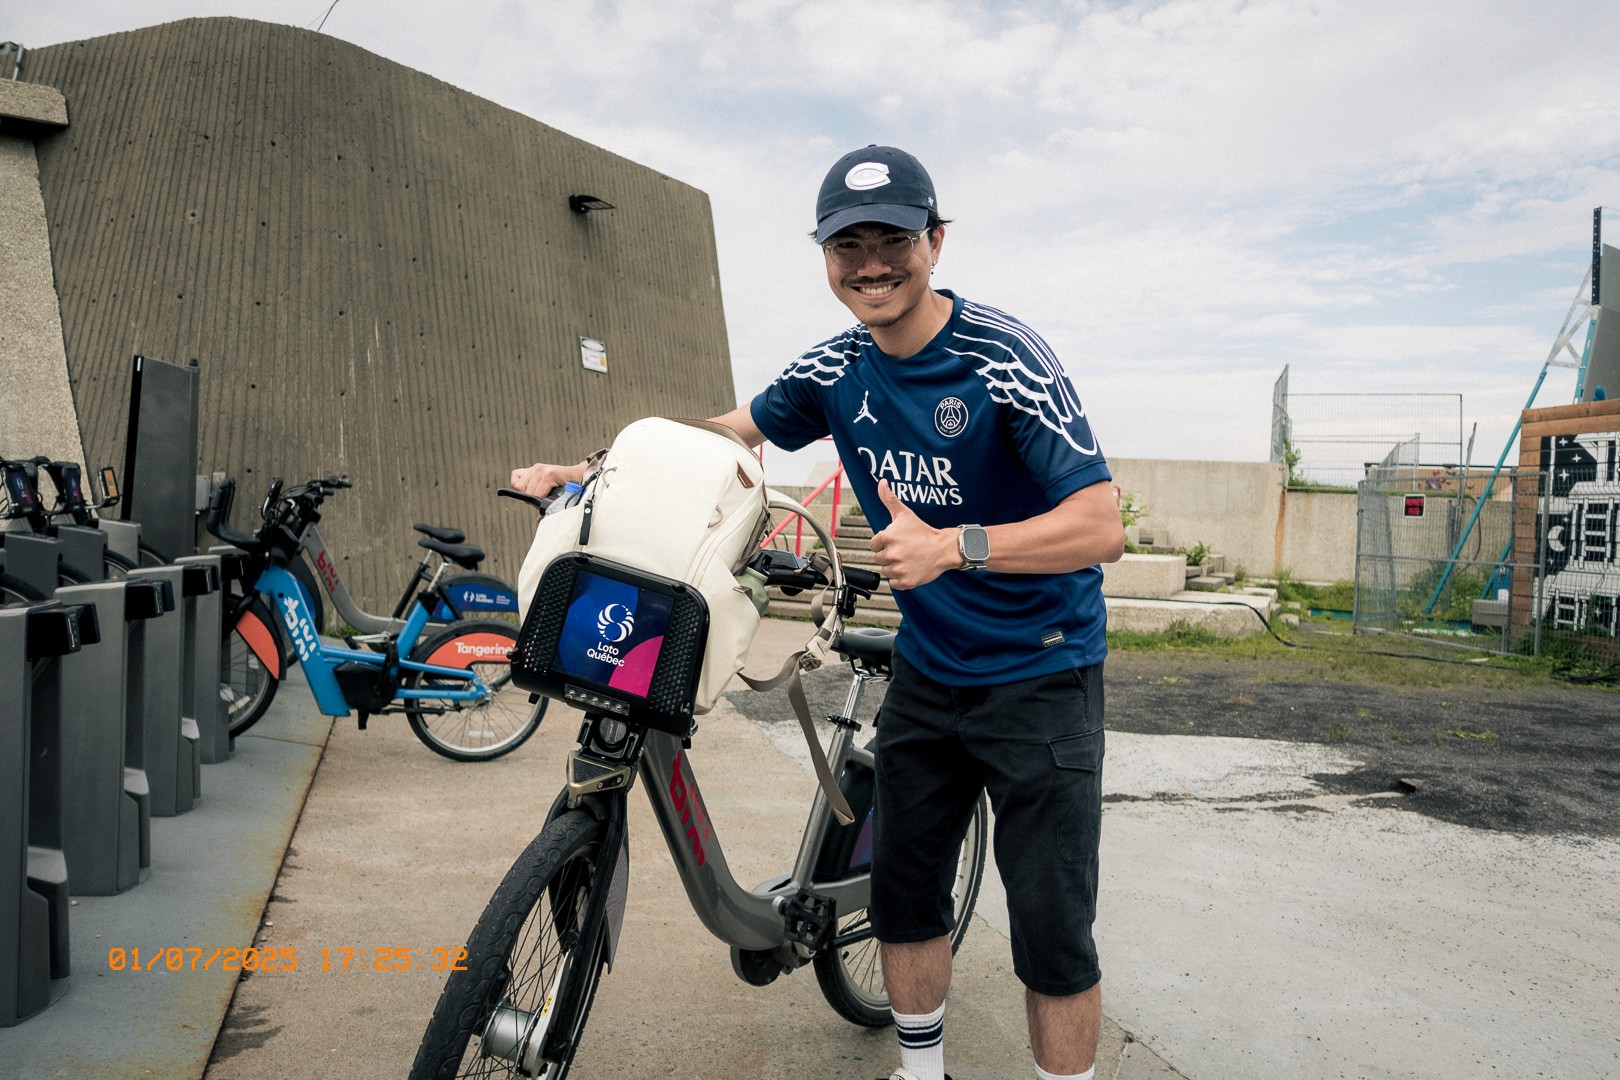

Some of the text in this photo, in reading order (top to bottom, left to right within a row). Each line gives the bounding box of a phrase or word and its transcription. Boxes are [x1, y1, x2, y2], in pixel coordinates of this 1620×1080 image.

[940, 399, 961, 410] PARIS
[890, 481, 963, 506] IRWAYS
[455, 641, 513, 657] Tangerine
[597, 641, 619, 656] Loto
[587, 648, 625, 667] Québec
